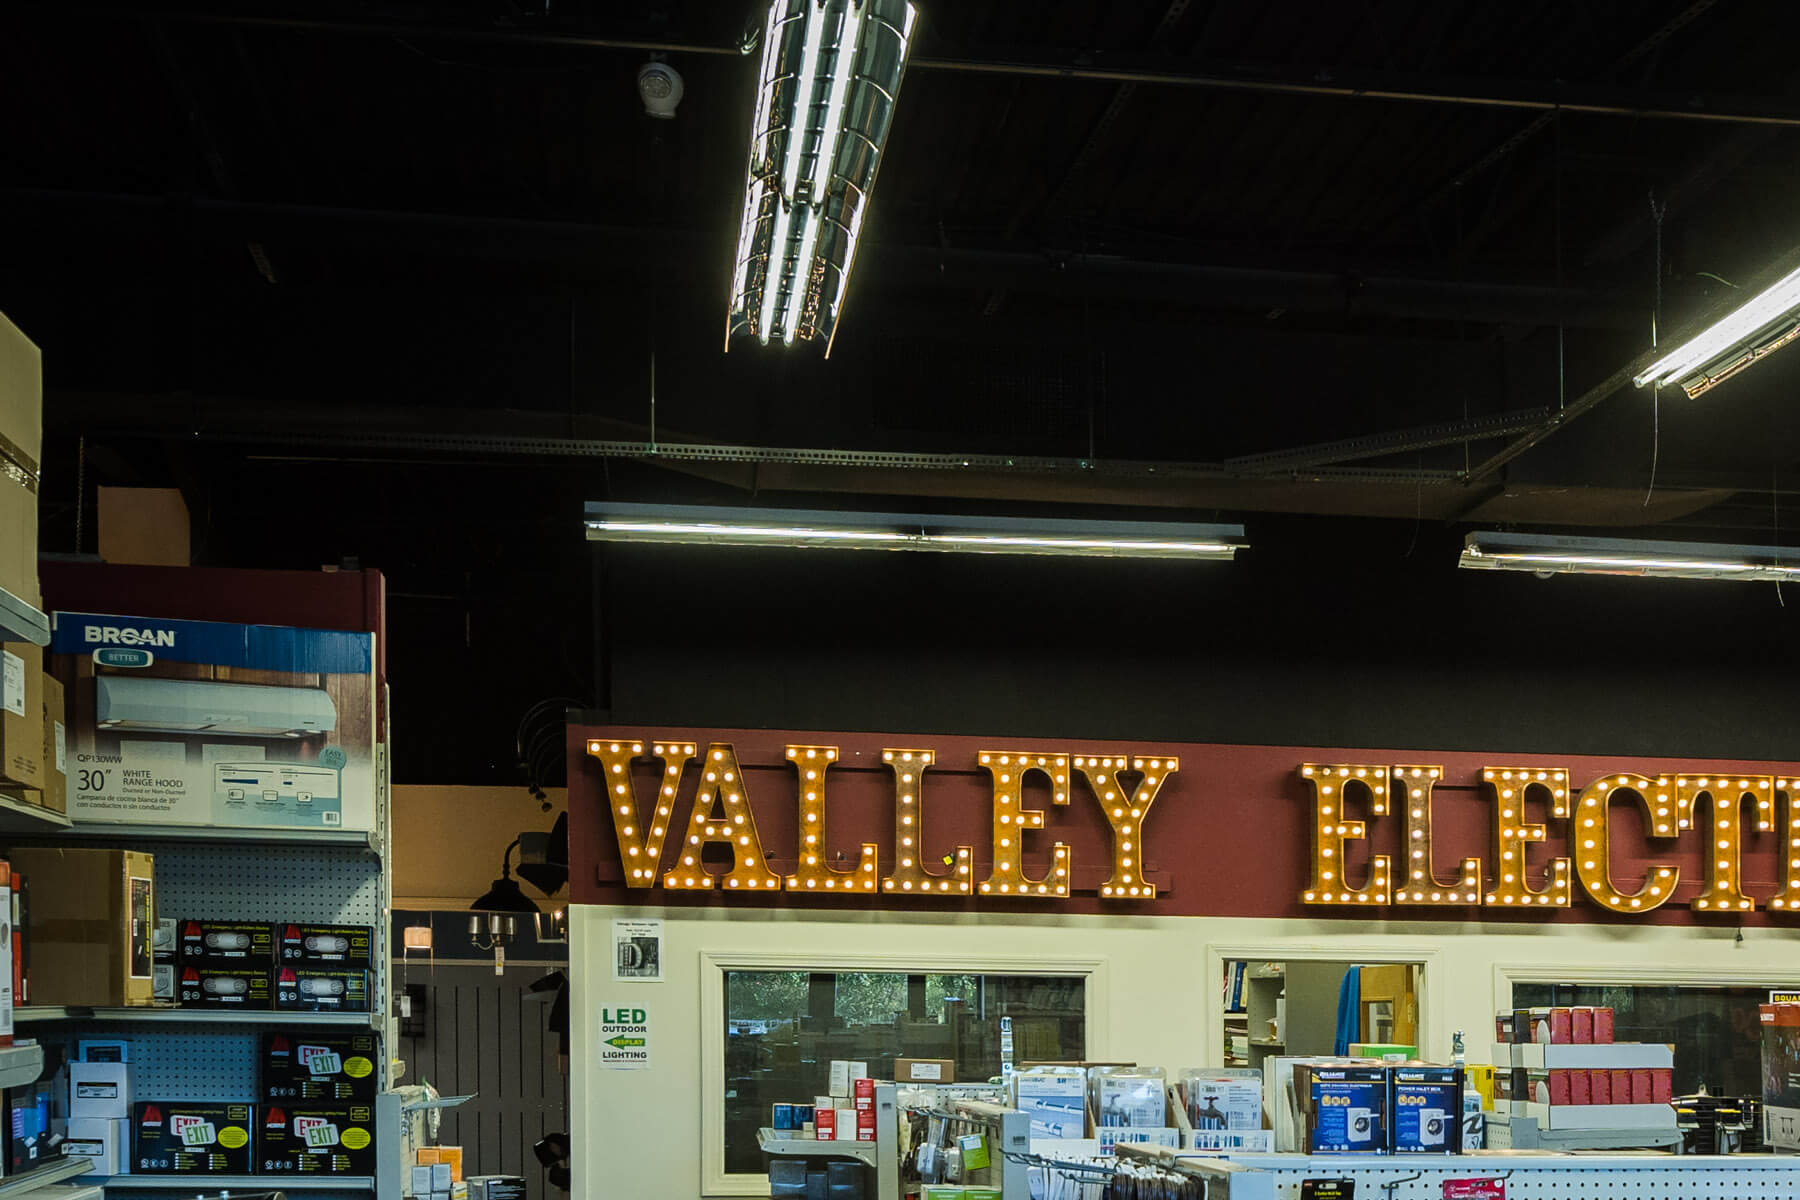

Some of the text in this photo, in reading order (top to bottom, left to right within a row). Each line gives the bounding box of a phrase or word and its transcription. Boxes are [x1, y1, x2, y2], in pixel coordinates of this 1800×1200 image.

[84, 625, 175, 647] BROAN
[108, 654, 139, 662] BETTER
[77, 768, 112, 792] 30"
[122, 770, 152, 778] WHITE
[122, 778, 183, 788] RANGE HOOD
[586, 738, 1180, 899] VALLEY
[602, 1008, 646, 1024] LED
[612, 1038, 644, 1046] DISPLAY
[602, 1051, 647, 1059] LIGHTING
[312, 1055, 336, 1073] EXIT
[185, 1126, 211, 1144] EXIT
[309, 1127, 334, 1145] EXIT
